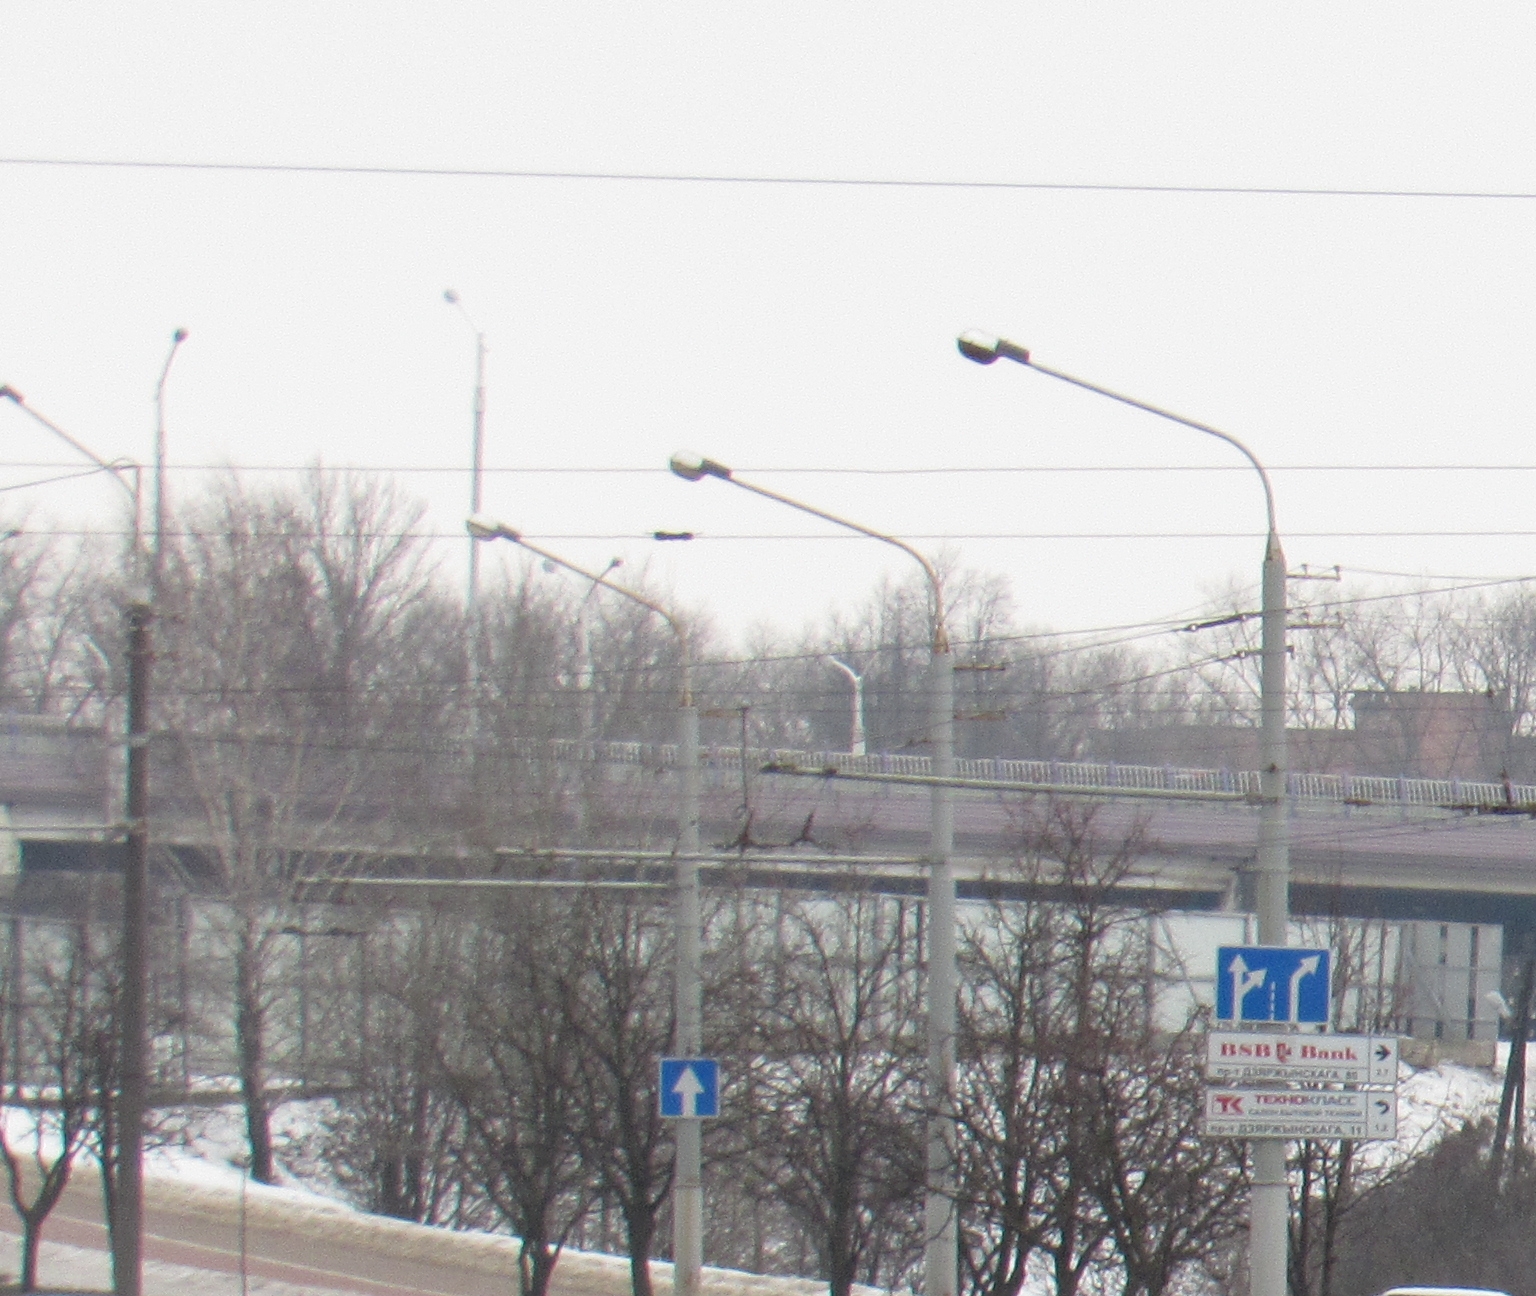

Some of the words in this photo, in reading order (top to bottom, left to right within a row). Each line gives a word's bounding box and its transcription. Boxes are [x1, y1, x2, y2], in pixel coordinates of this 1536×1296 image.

[1220, 1042, 1271, 1058] BSB
[1300, 1044, 1358, 1061] Bank
[1254, 1093, 1358, 1106] ТЕХНОКЛАСС
